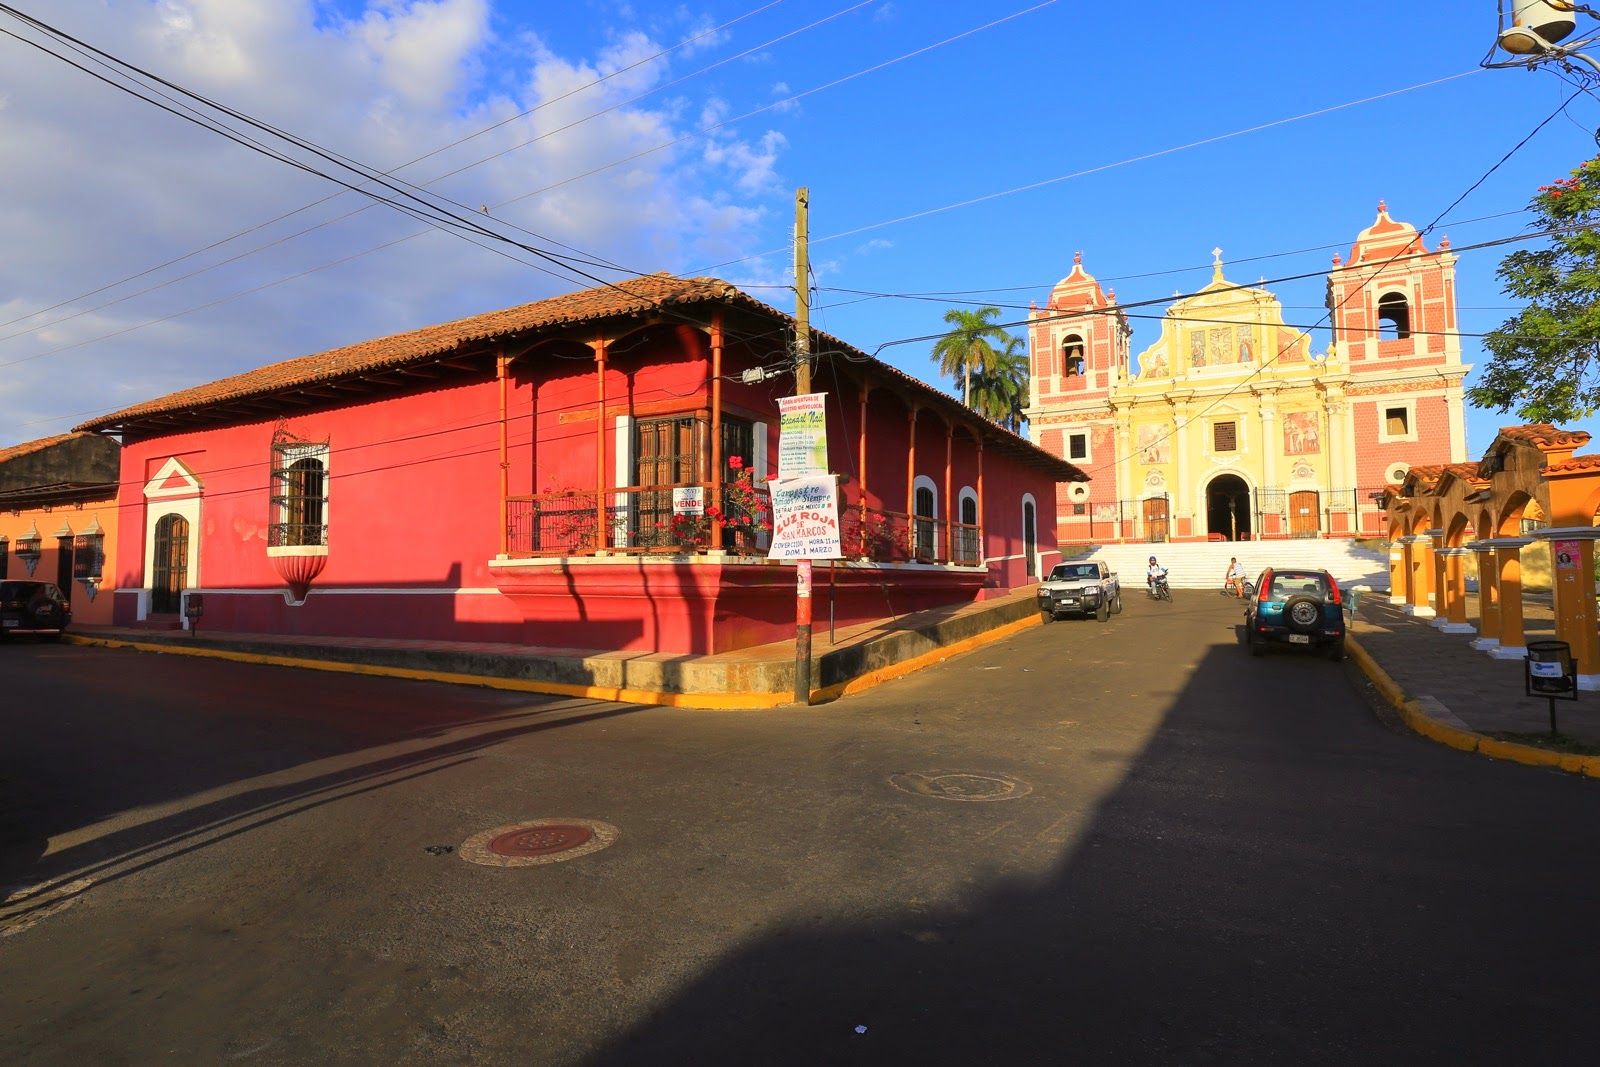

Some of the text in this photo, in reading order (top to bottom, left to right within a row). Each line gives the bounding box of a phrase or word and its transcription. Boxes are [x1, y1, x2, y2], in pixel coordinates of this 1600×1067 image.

[776, 485, 819, 498] Campestre
[802, 494, 831, 503] Siempre
[777, 512, 836, 535] LUZ ROJA
[782, 526, 826, 540] SAN MARCOS
